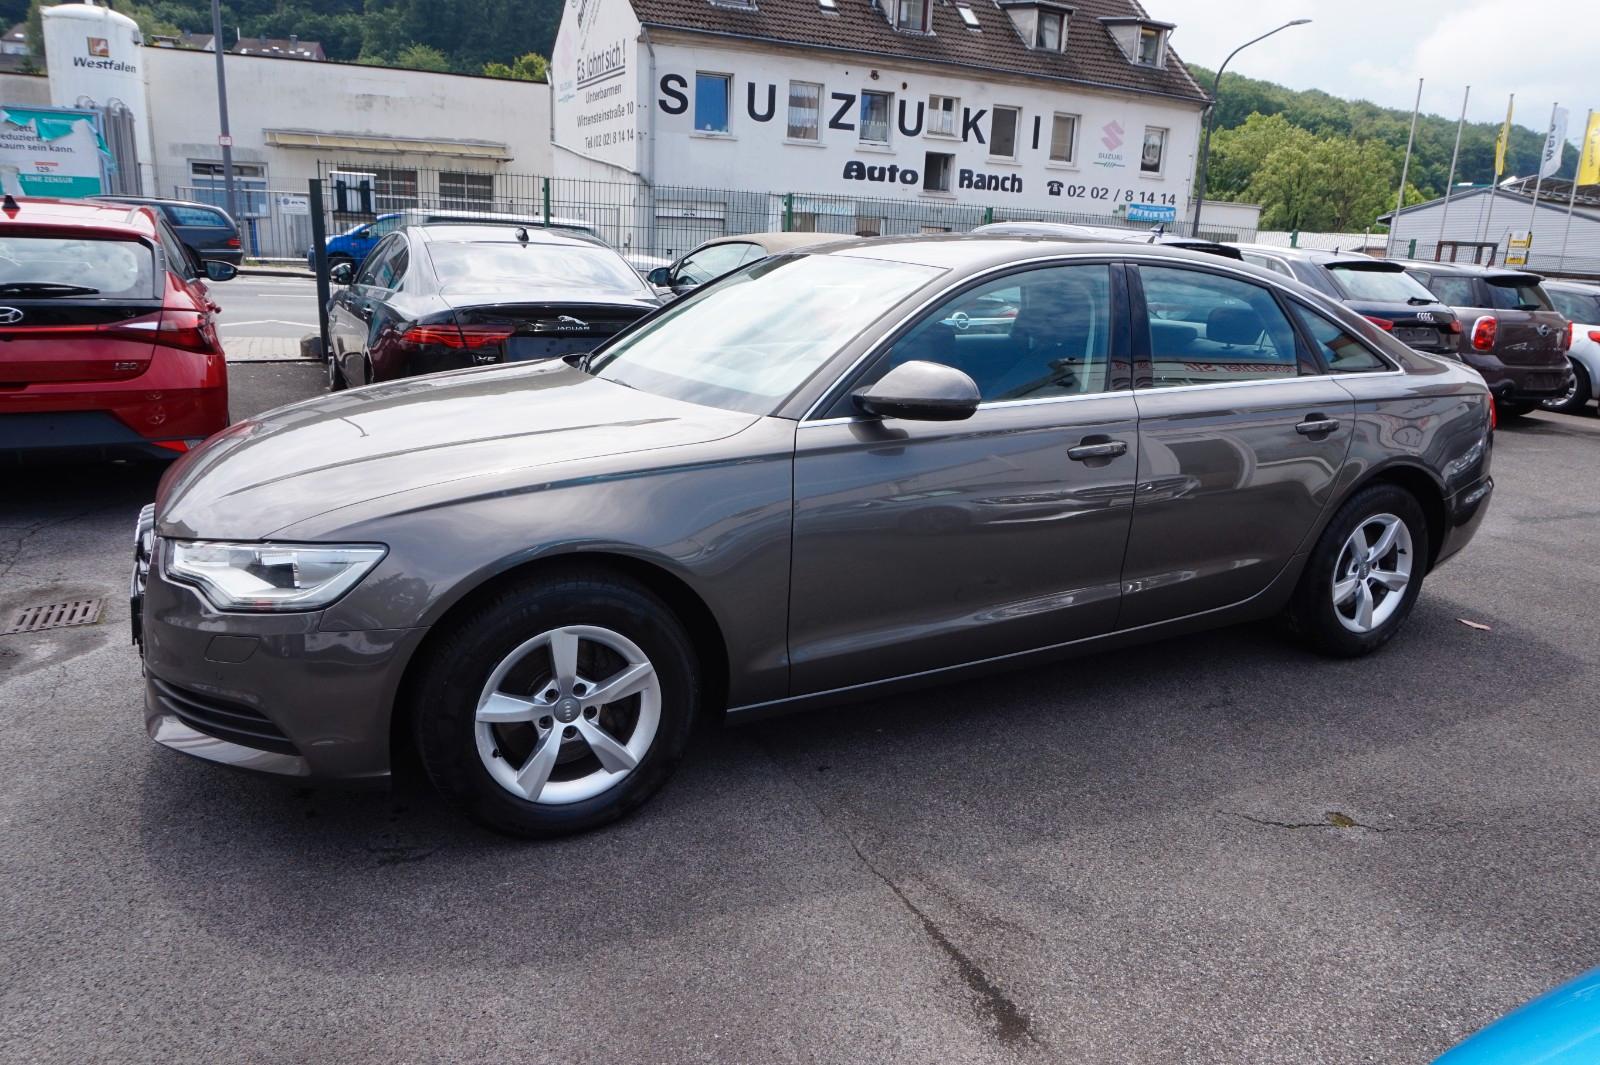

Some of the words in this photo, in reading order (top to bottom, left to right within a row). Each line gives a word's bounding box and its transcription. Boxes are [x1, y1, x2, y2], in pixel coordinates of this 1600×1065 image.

[73, 56, 137, 73] Westfalen
[577, 58, 585, 81] Es
[586, 52, 605, 78] lohnt
[605, 41, 621, 70] sich
[585, 84, 622, 104] Unterbarmen
[576, 103, 625, 128] Wittensteinstraße
[626, 101, 634, 114] 10
[612, 131, 617, 144] 8
[618, 130, 625, 143] 14
[627, 128, 634, 142] 14
[843, 160, 919, 185] Auto
[1067, 184, 1086, 198] 02
[1090, 186, 1109, 200] 02
[1113, 188, 1120, 202] /
[1125, 190, 1134, 202] 8
[1139, 191, 1155, 204] 14
[1160, 193, 1176, 205] 14
